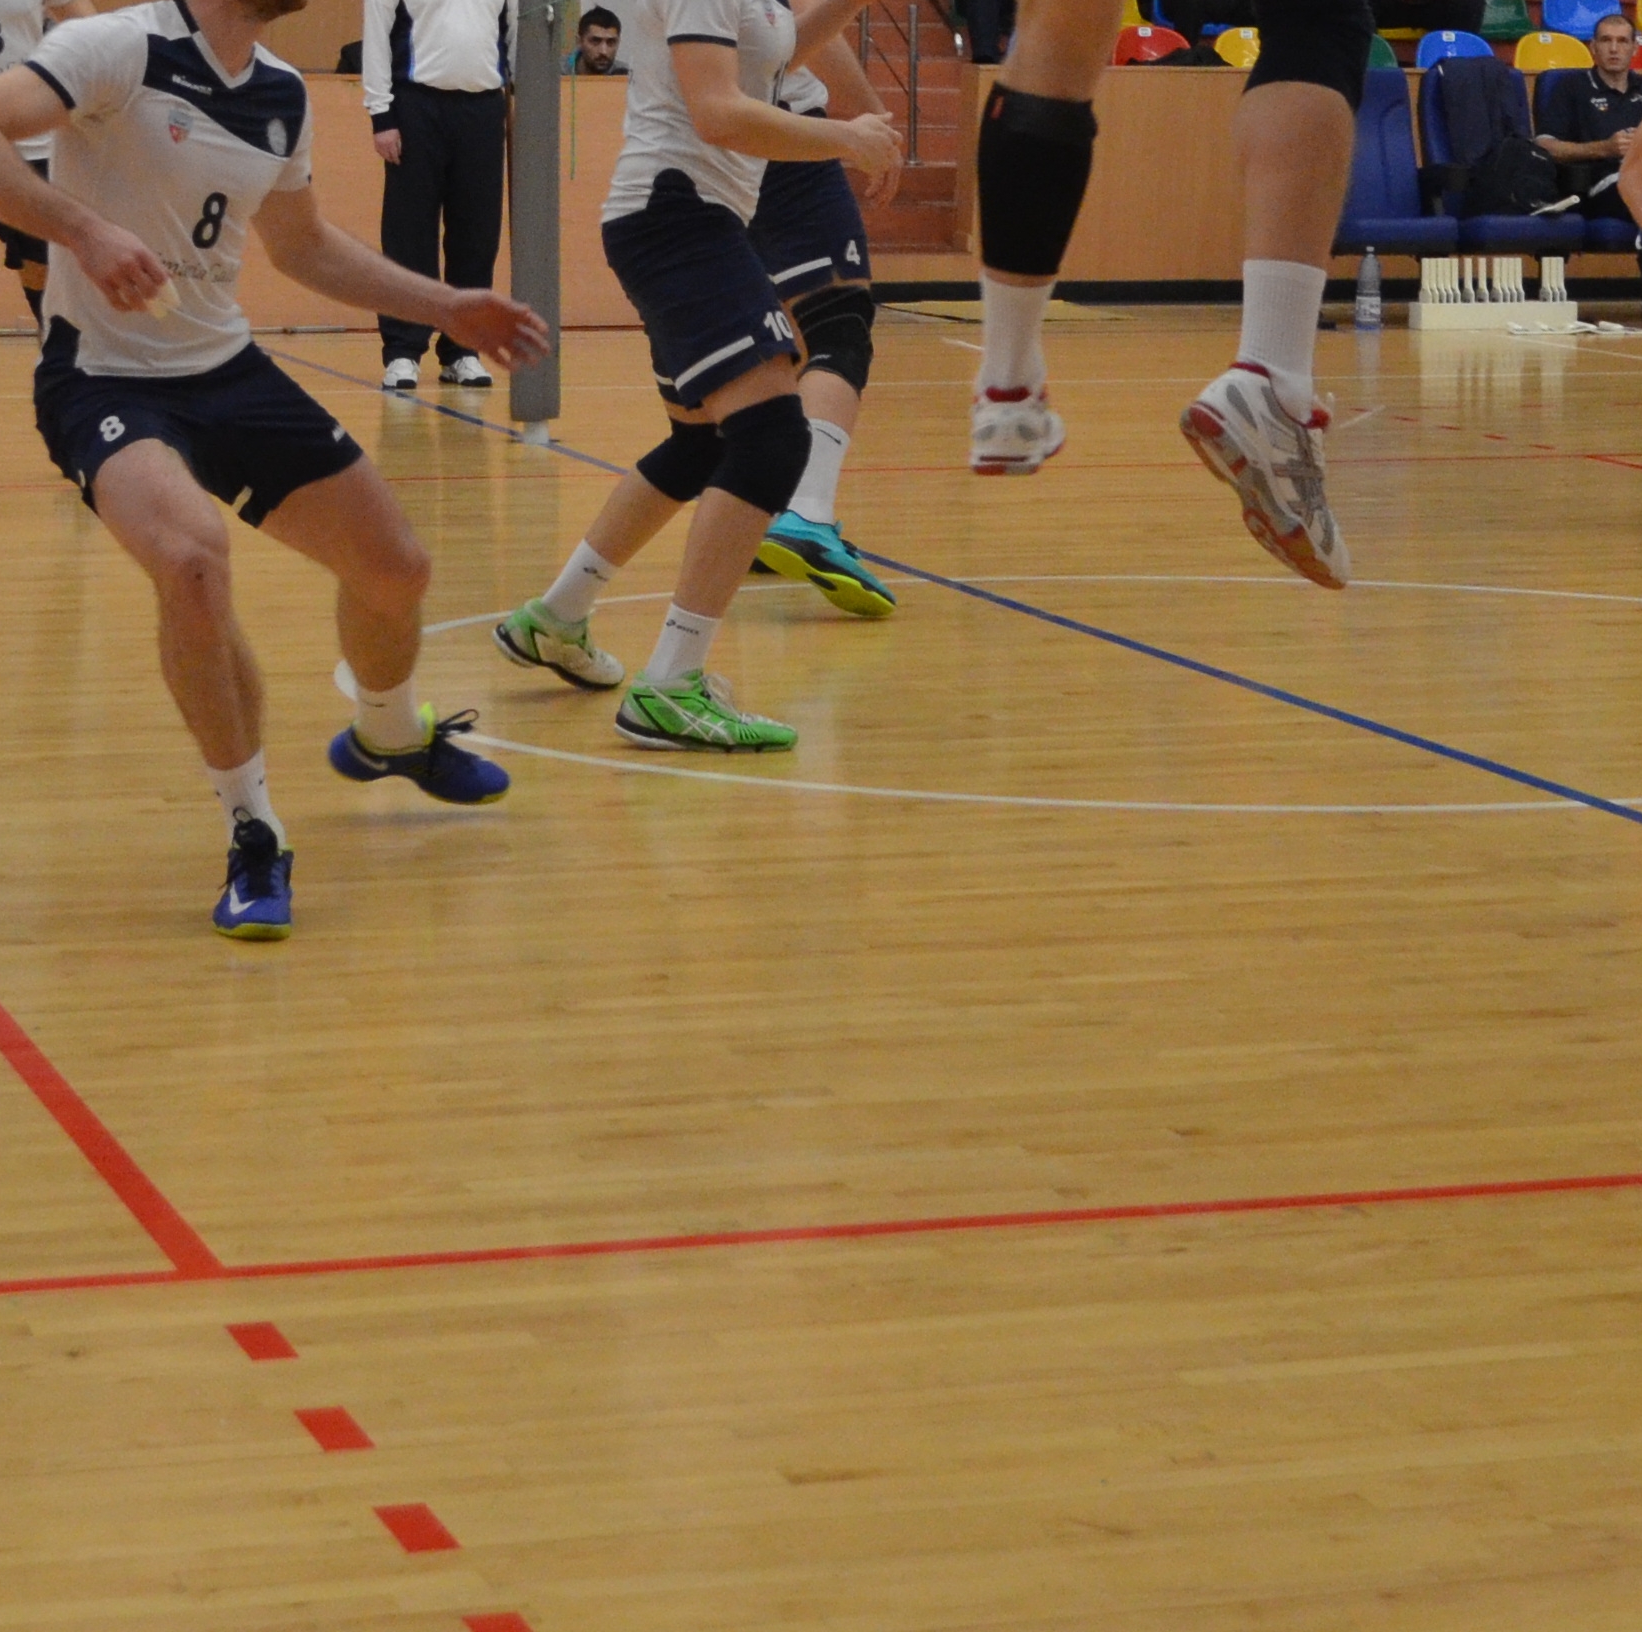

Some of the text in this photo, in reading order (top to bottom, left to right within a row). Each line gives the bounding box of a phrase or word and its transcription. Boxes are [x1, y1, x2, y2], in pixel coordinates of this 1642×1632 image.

[192, 191, 228, 249] 8
[845, 239, 861, 265] 4
[763, 310, 794, 341] 10
[99, 415, 125, 442] 8
